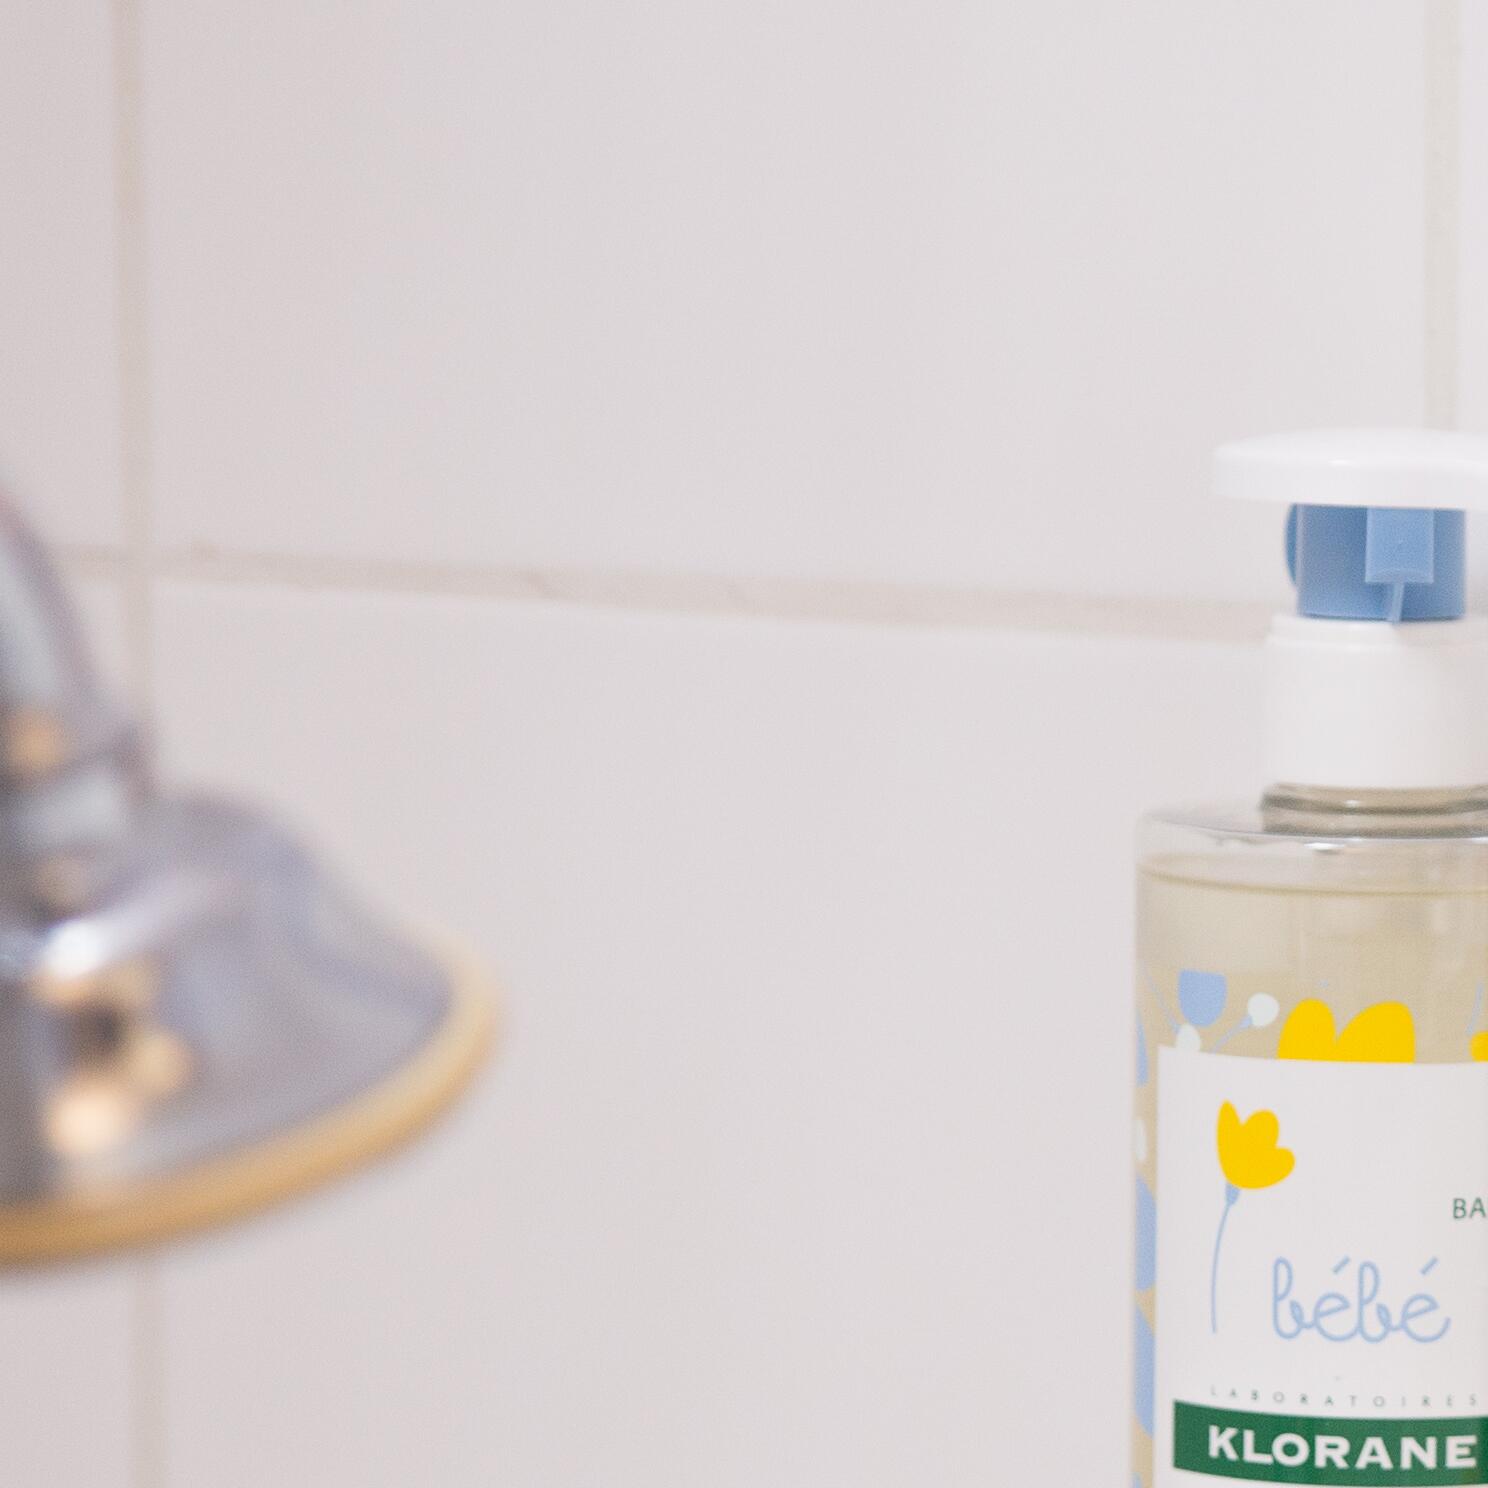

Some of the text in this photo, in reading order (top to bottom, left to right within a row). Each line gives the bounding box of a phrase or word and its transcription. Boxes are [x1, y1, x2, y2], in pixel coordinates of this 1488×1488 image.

[1272, 1256, 1451, 1343] bébé
[1210, 1385, 1478, 1408] LABORATOIRES
[1208, 1424, 1478, 1470] KLORANE
